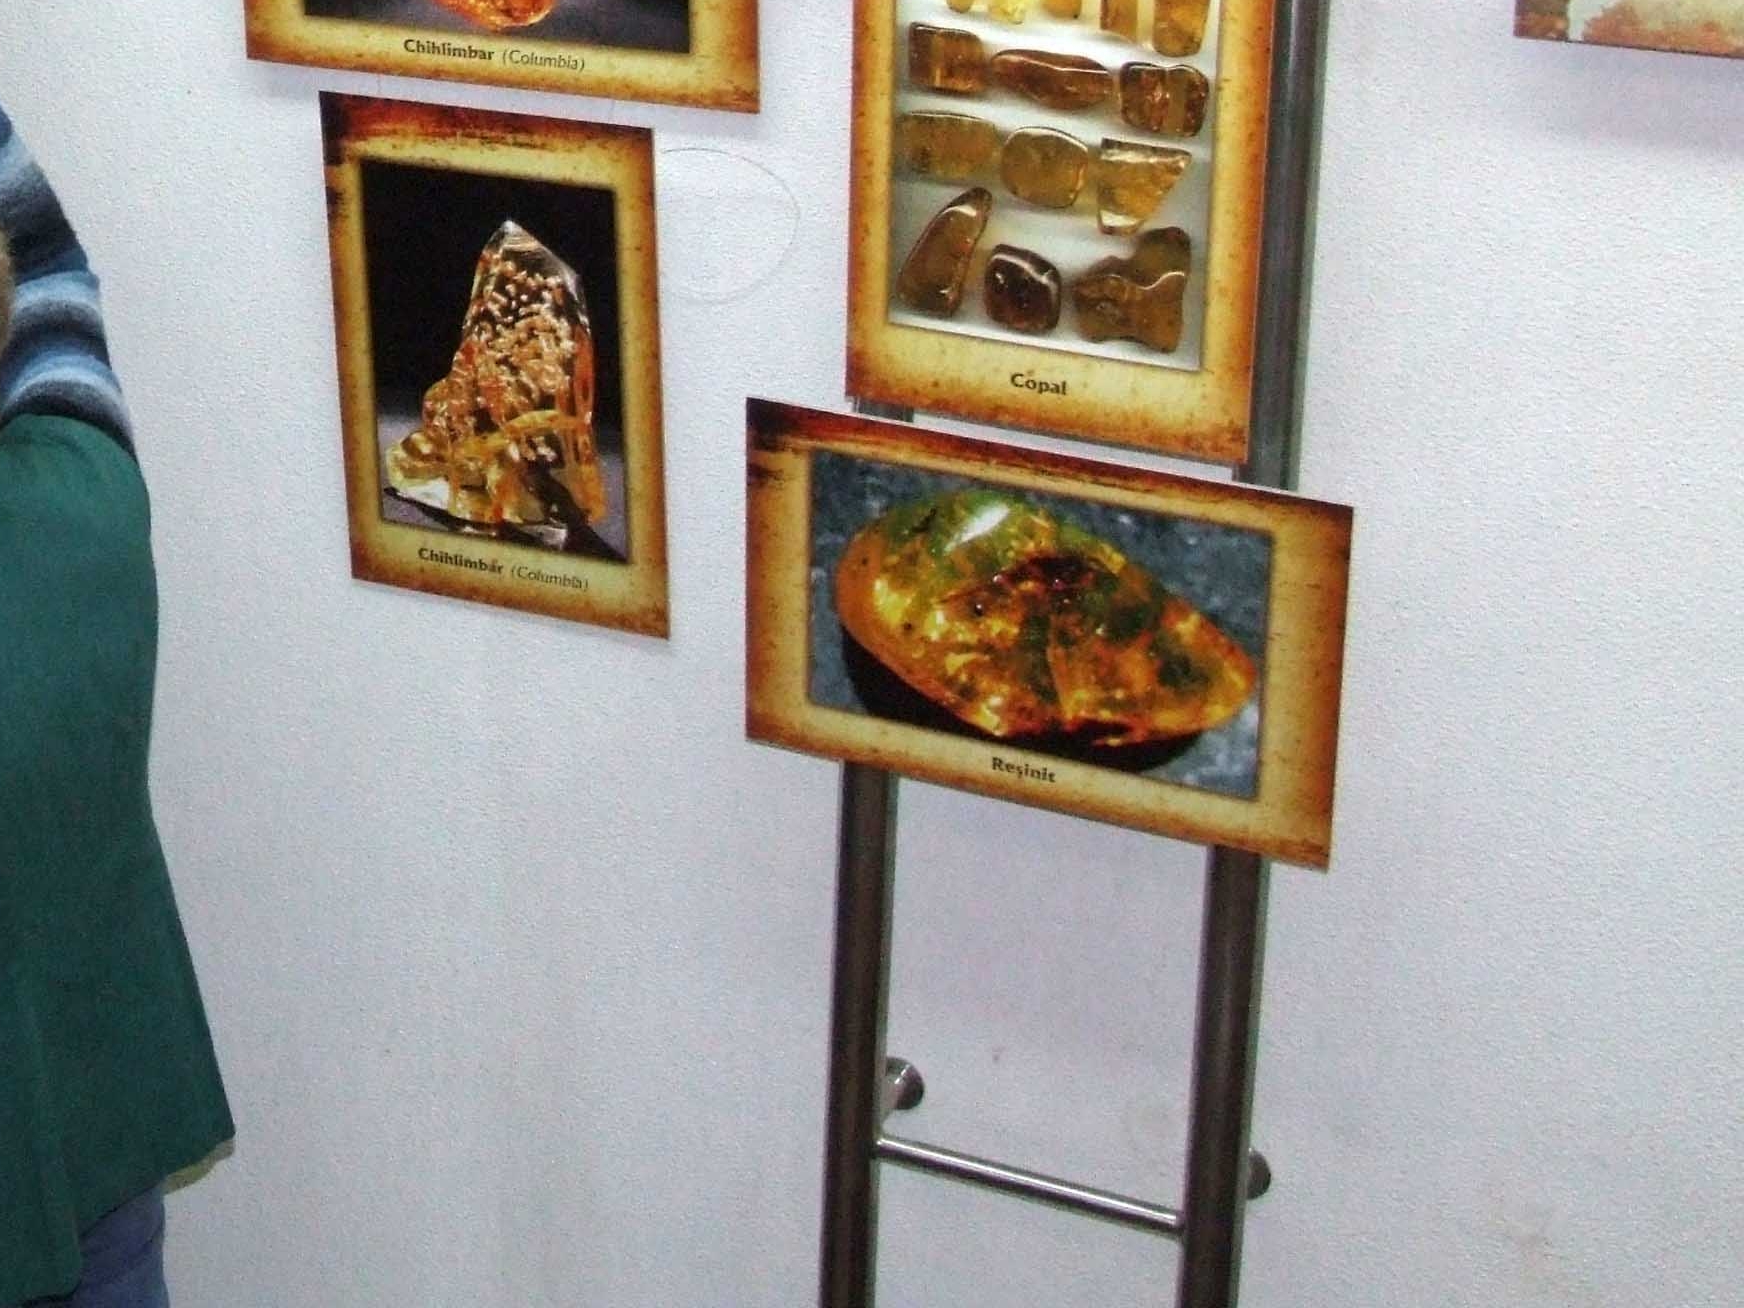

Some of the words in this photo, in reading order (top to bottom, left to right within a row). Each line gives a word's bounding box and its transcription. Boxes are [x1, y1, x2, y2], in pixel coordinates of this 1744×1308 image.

[403, 39, 494, 62] Chihlimbar
[503, 49, 585, 72] (Columbia)
[1010, 373, 1067, 395] Copal
[418, 548, 503, 574] Chihlimbar
